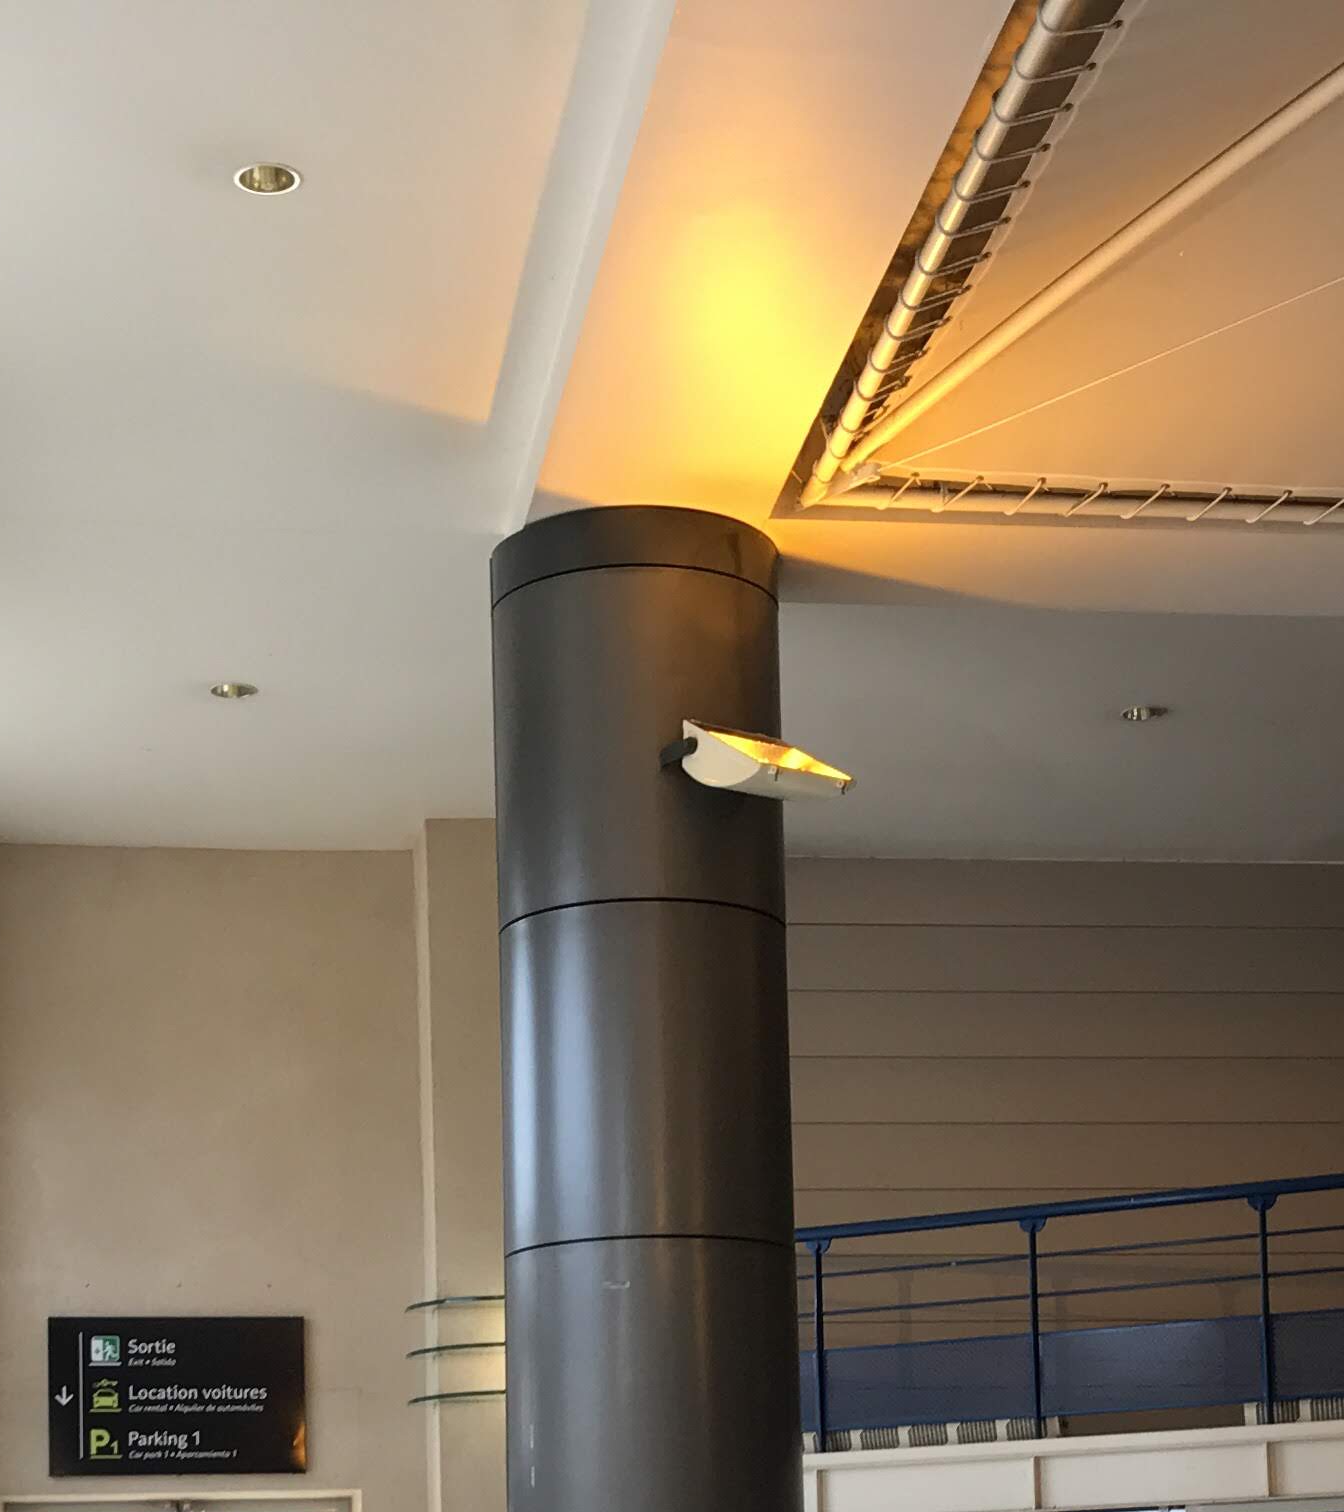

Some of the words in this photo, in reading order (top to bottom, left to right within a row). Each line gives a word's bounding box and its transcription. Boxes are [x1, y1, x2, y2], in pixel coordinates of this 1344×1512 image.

[127, 1338, 176, 1354] Sortie
[128, 1384, 198, 1400] Location
[201, 1384, 267, 1400] voitures
[128, 1430, 188, 1450] Parking
[192, 1430, 200, 1446] 1
